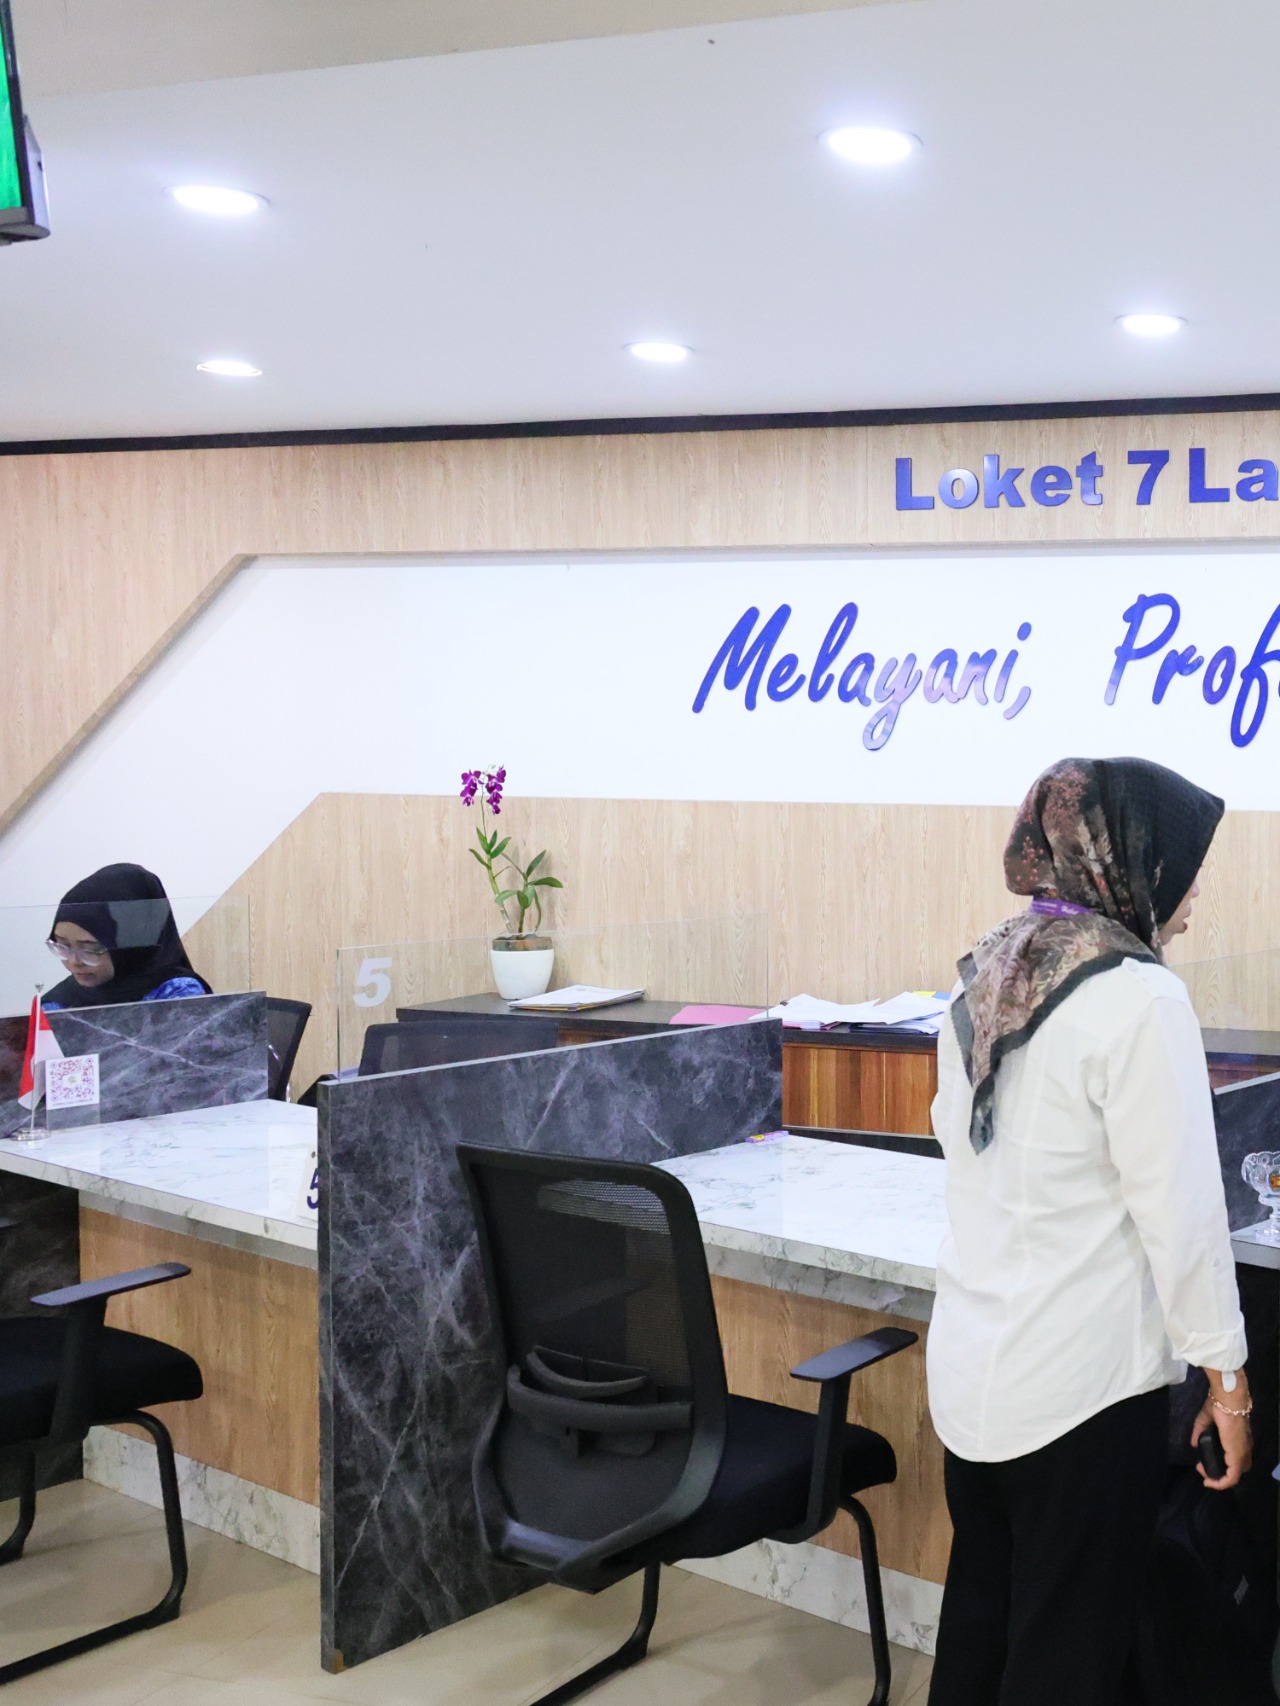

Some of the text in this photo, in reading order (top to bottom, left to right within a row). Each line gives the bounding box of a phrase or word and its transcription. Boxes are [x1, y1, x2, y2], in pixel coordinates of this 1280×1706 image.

[895, 453, 1104, 511] Loket
[1127, 449, 1170, 505] 7
[692, 602, 1032, 751] Melayani,
[352, 957, 393, 1008] 5
